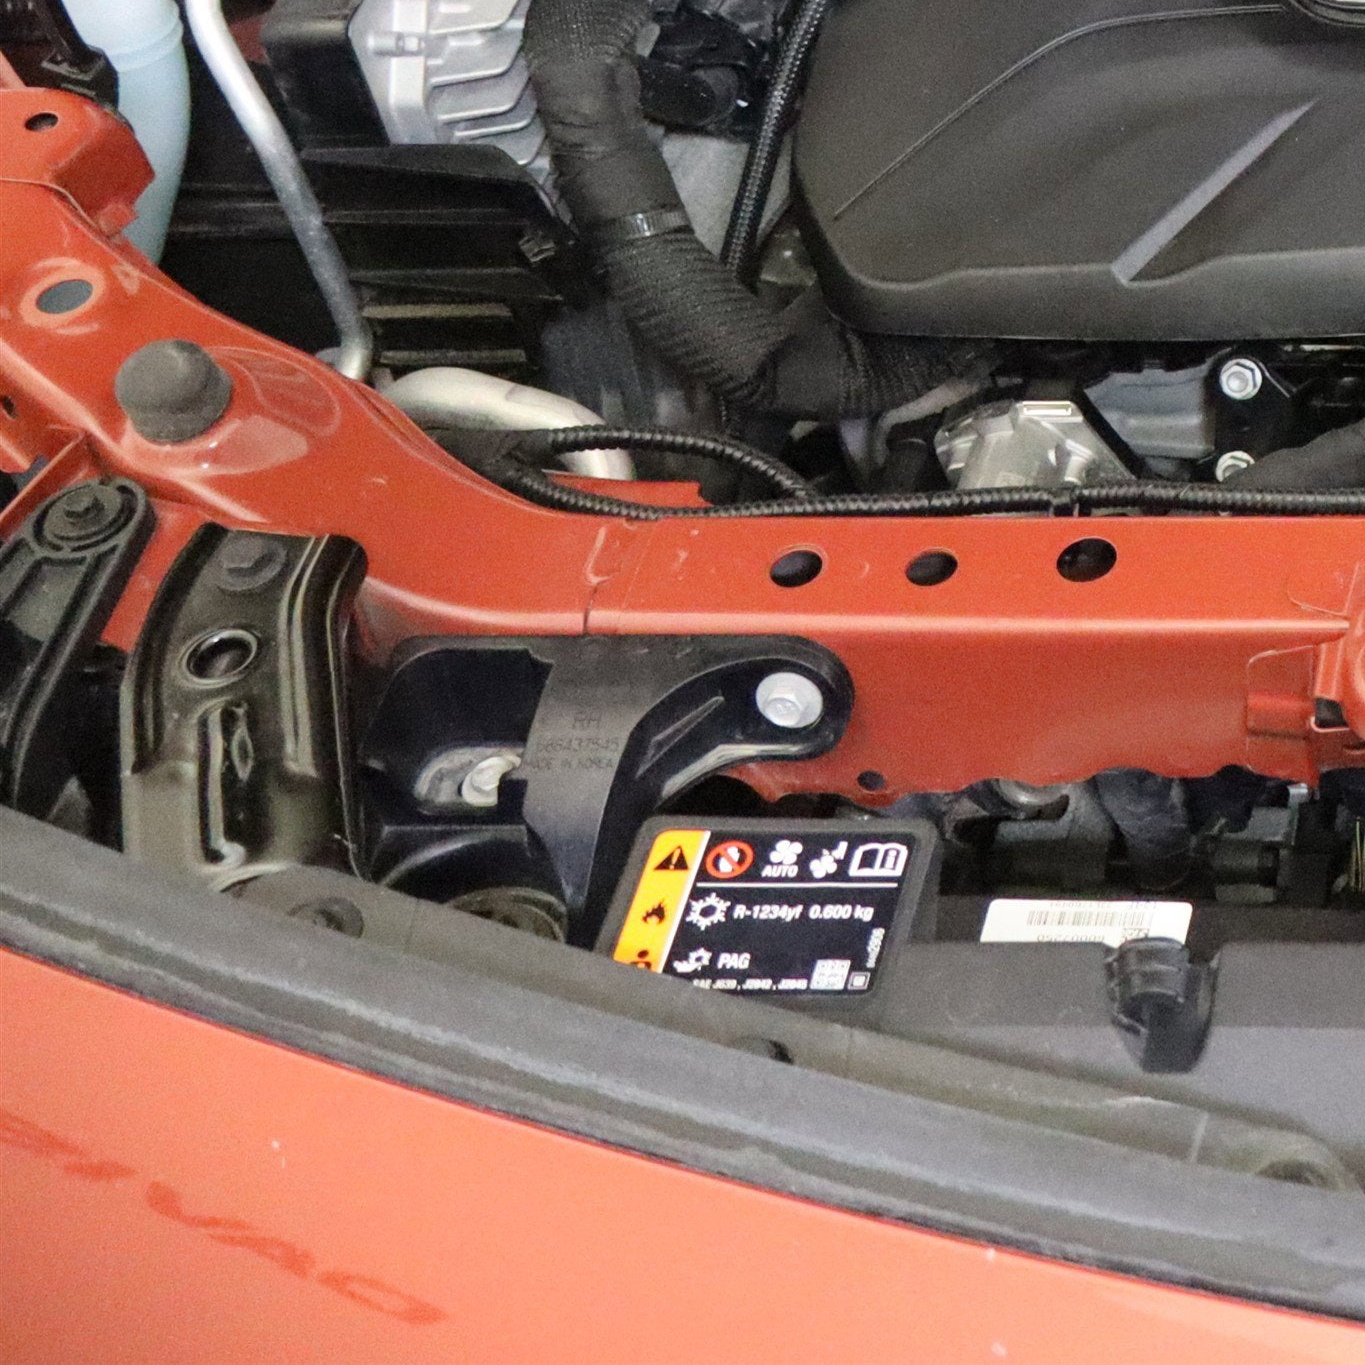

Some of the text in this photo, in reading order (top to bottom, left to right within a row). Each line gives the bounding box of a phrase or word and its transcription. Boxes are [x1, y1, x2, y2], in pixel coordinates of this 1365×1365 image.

[761, 865, 799, 878] AUTO
[732, 904, 875, 922] R-1234yf 0.600 kg
[717, 952, 751, 969] PAG
